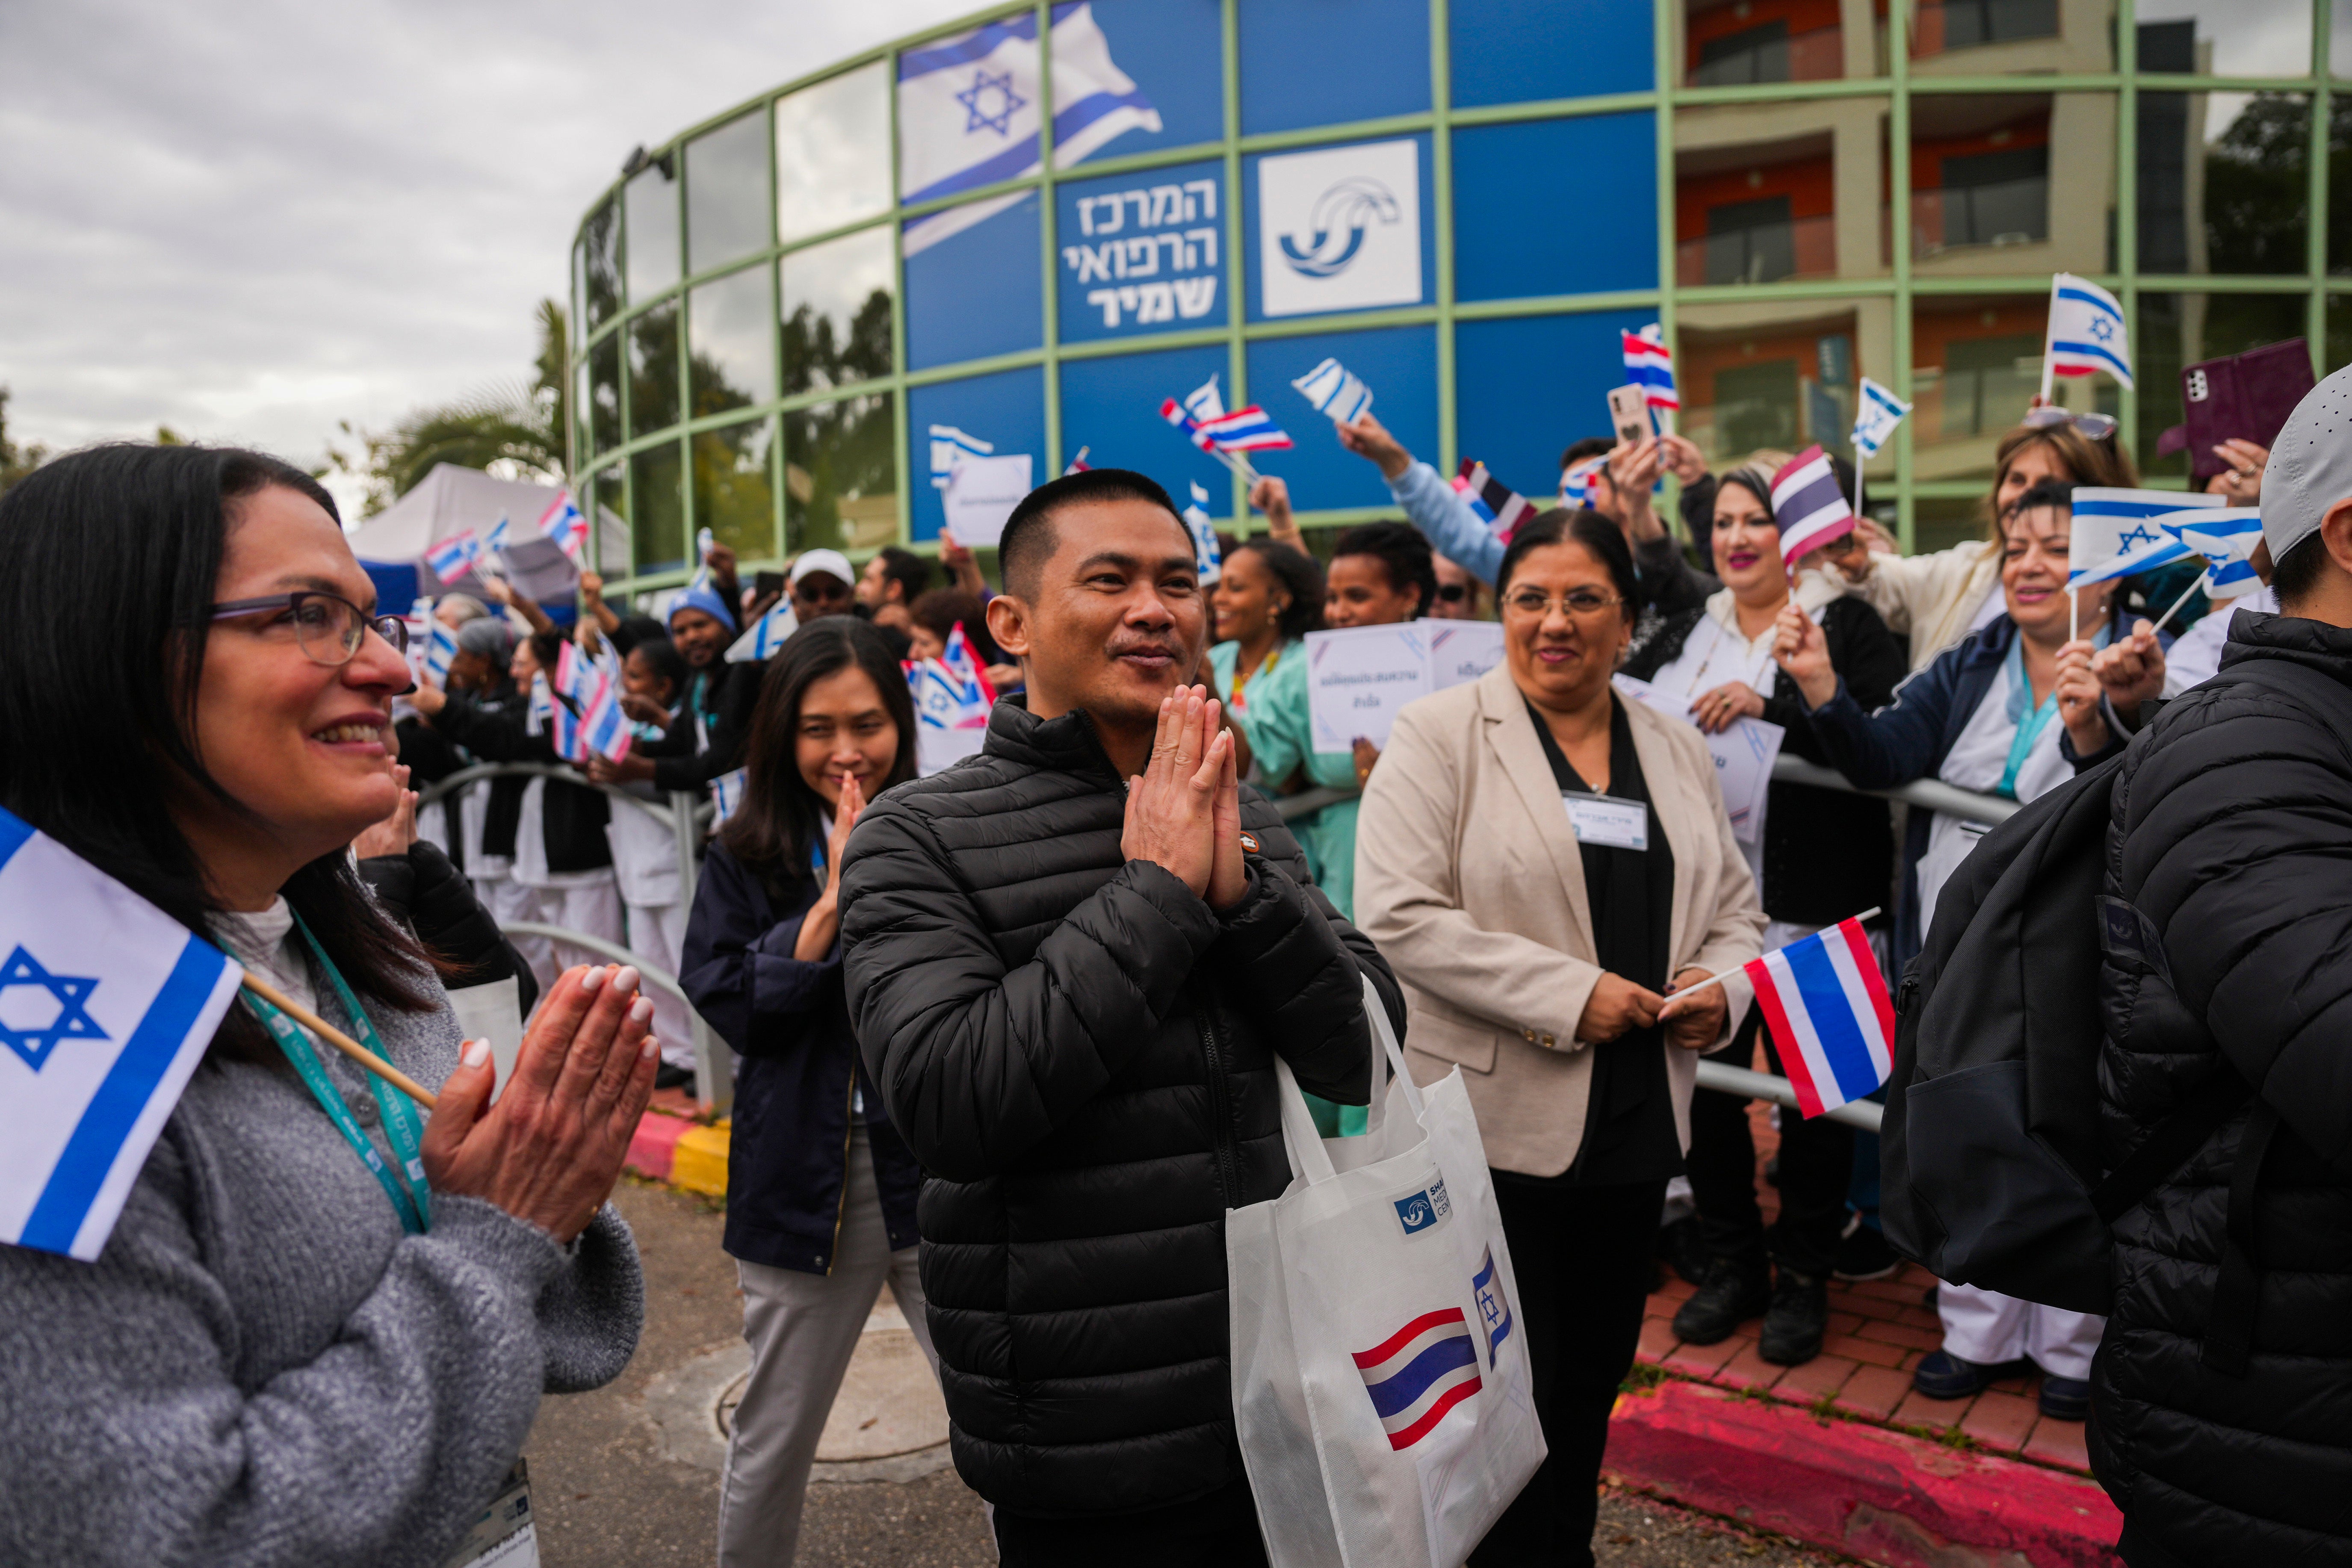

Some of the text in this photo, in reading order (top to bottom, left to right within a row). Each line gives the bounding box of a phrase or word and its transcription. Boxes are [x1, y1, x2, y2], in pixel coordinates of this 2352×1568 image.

[1076, 178, 1217, 236] המרכז
[1062, 227, 1218, 283] הרפואי
[1087, 275, 1218, 328] שמיר
